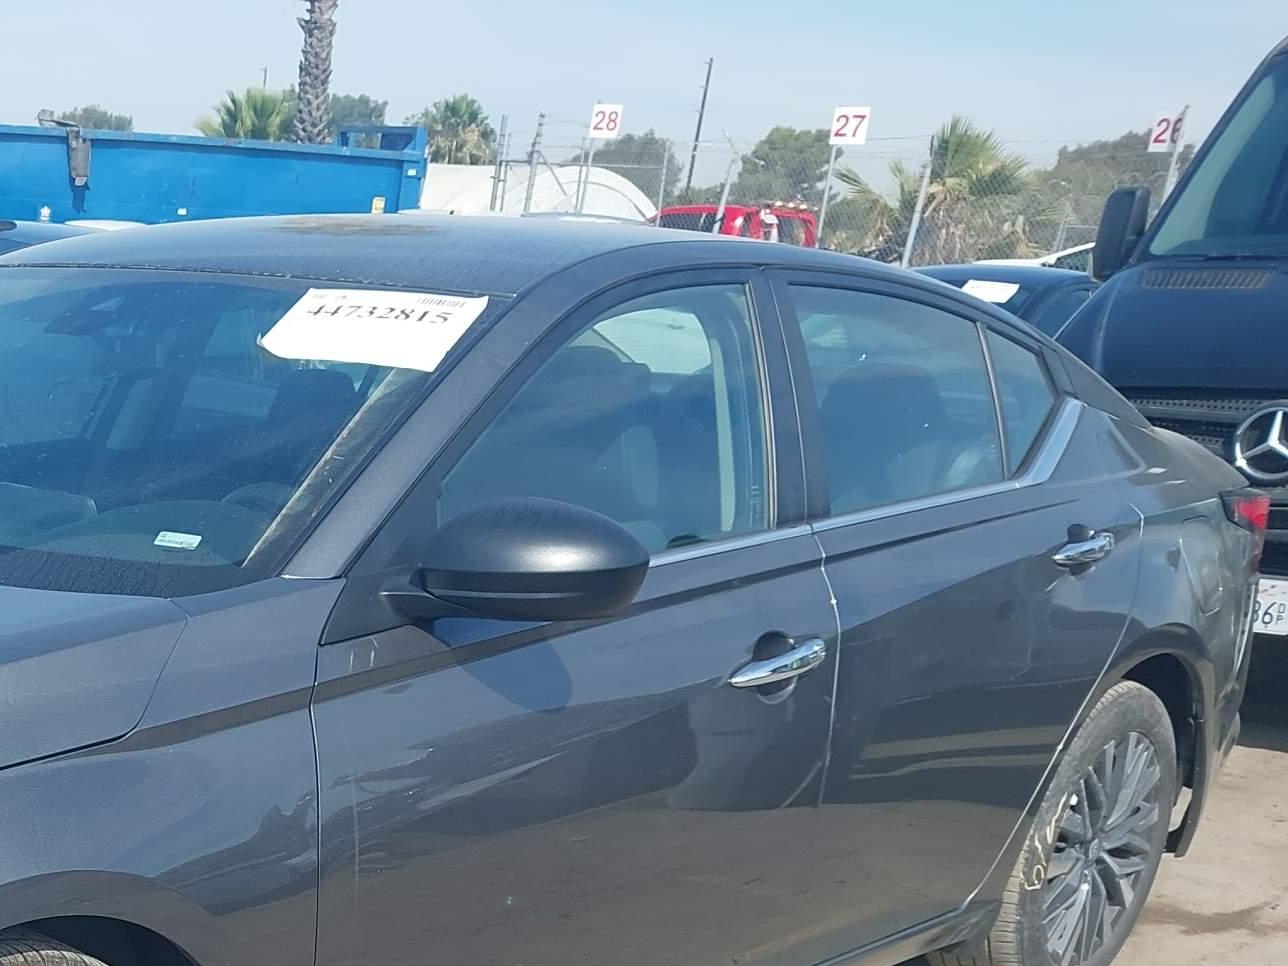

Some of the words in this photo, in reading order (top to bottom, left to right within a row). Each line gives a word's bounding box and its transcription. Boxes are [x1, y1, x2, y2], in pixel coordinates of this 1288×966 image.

[592, 110, 619, 132] 28
[833, 114, 867, 138] 27
[307, 304, 453, 324] 44732815
